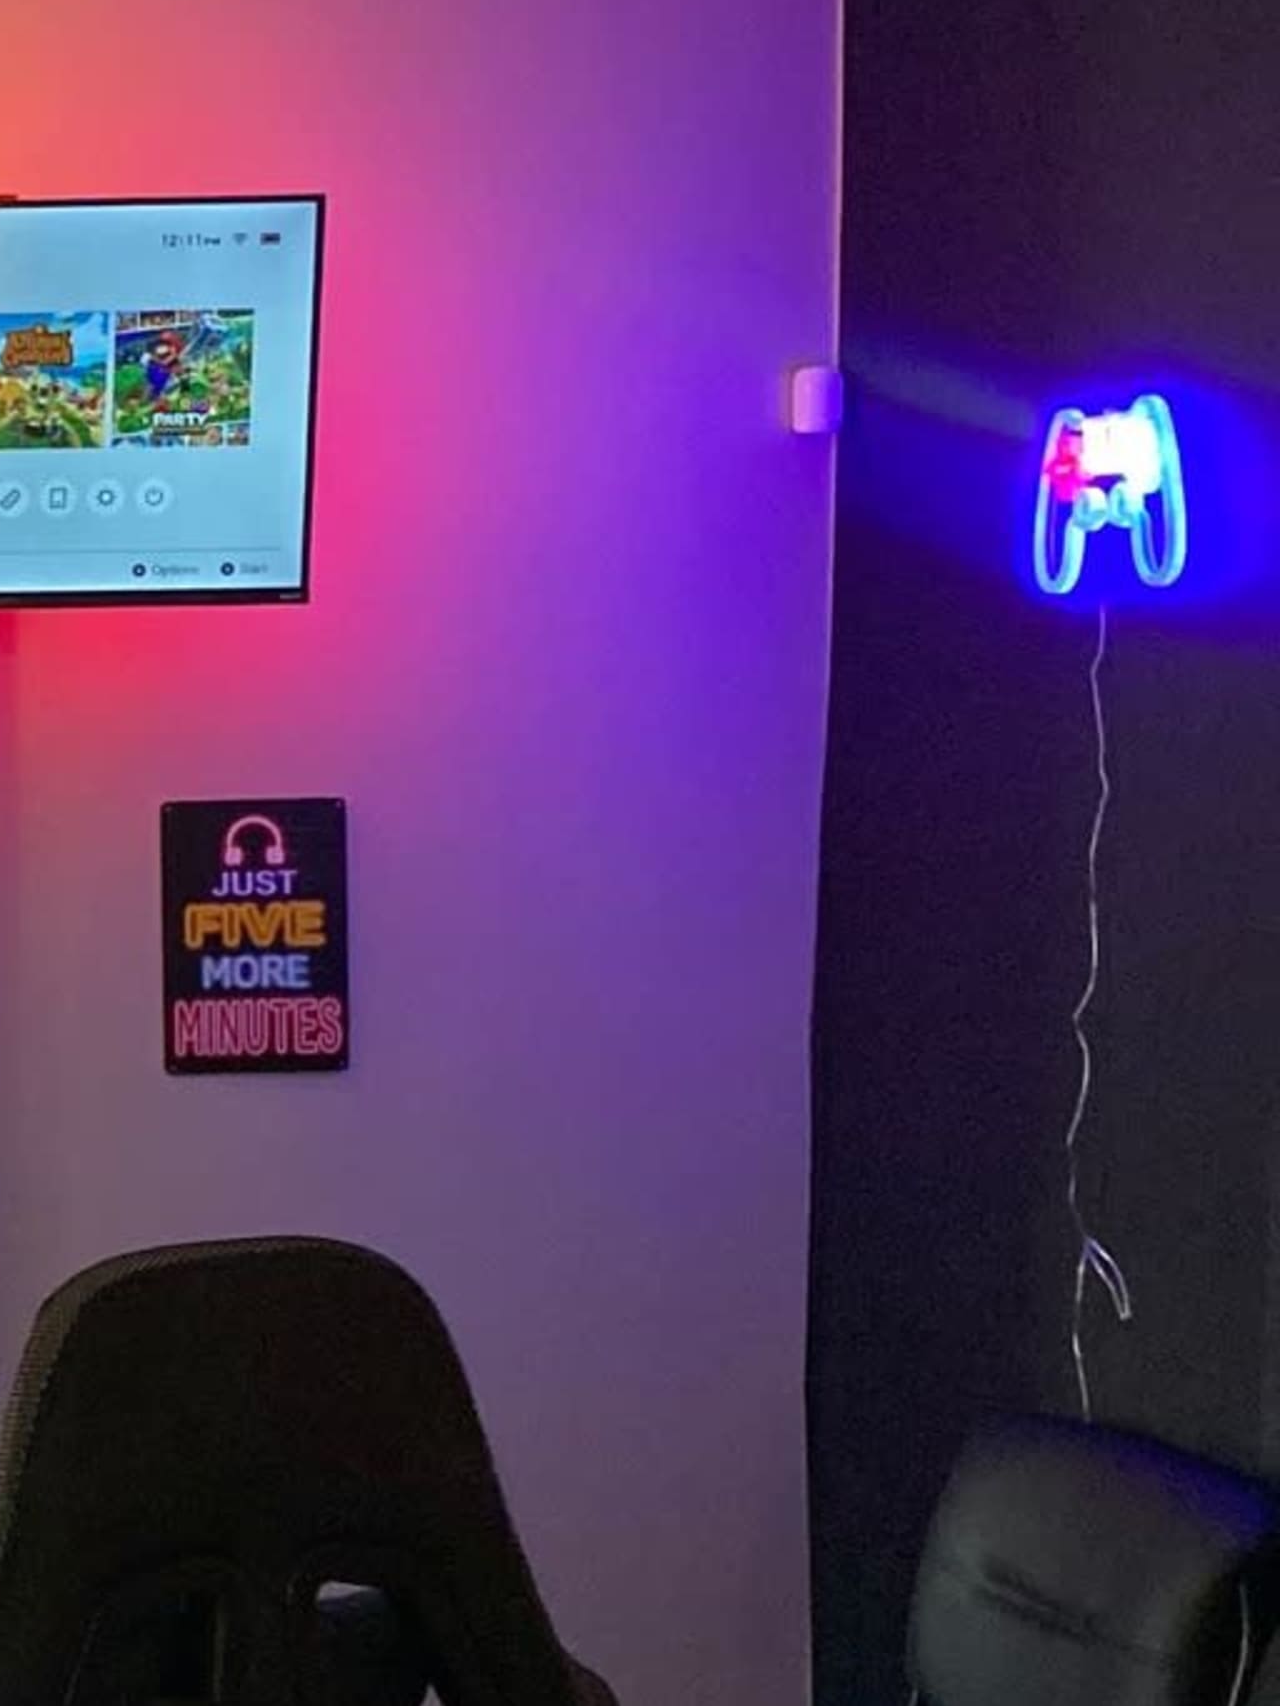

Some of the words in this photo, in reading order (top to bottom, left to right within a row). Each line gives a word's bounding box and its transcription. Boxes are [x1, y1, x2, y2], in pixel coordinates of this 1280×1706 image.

[211, 869, 299, 897] JUST
[183, 899, 327, 949] FIVE
[201, 954, 312, 990] MORE
[173, 996, 344, 1057] MINUTES
